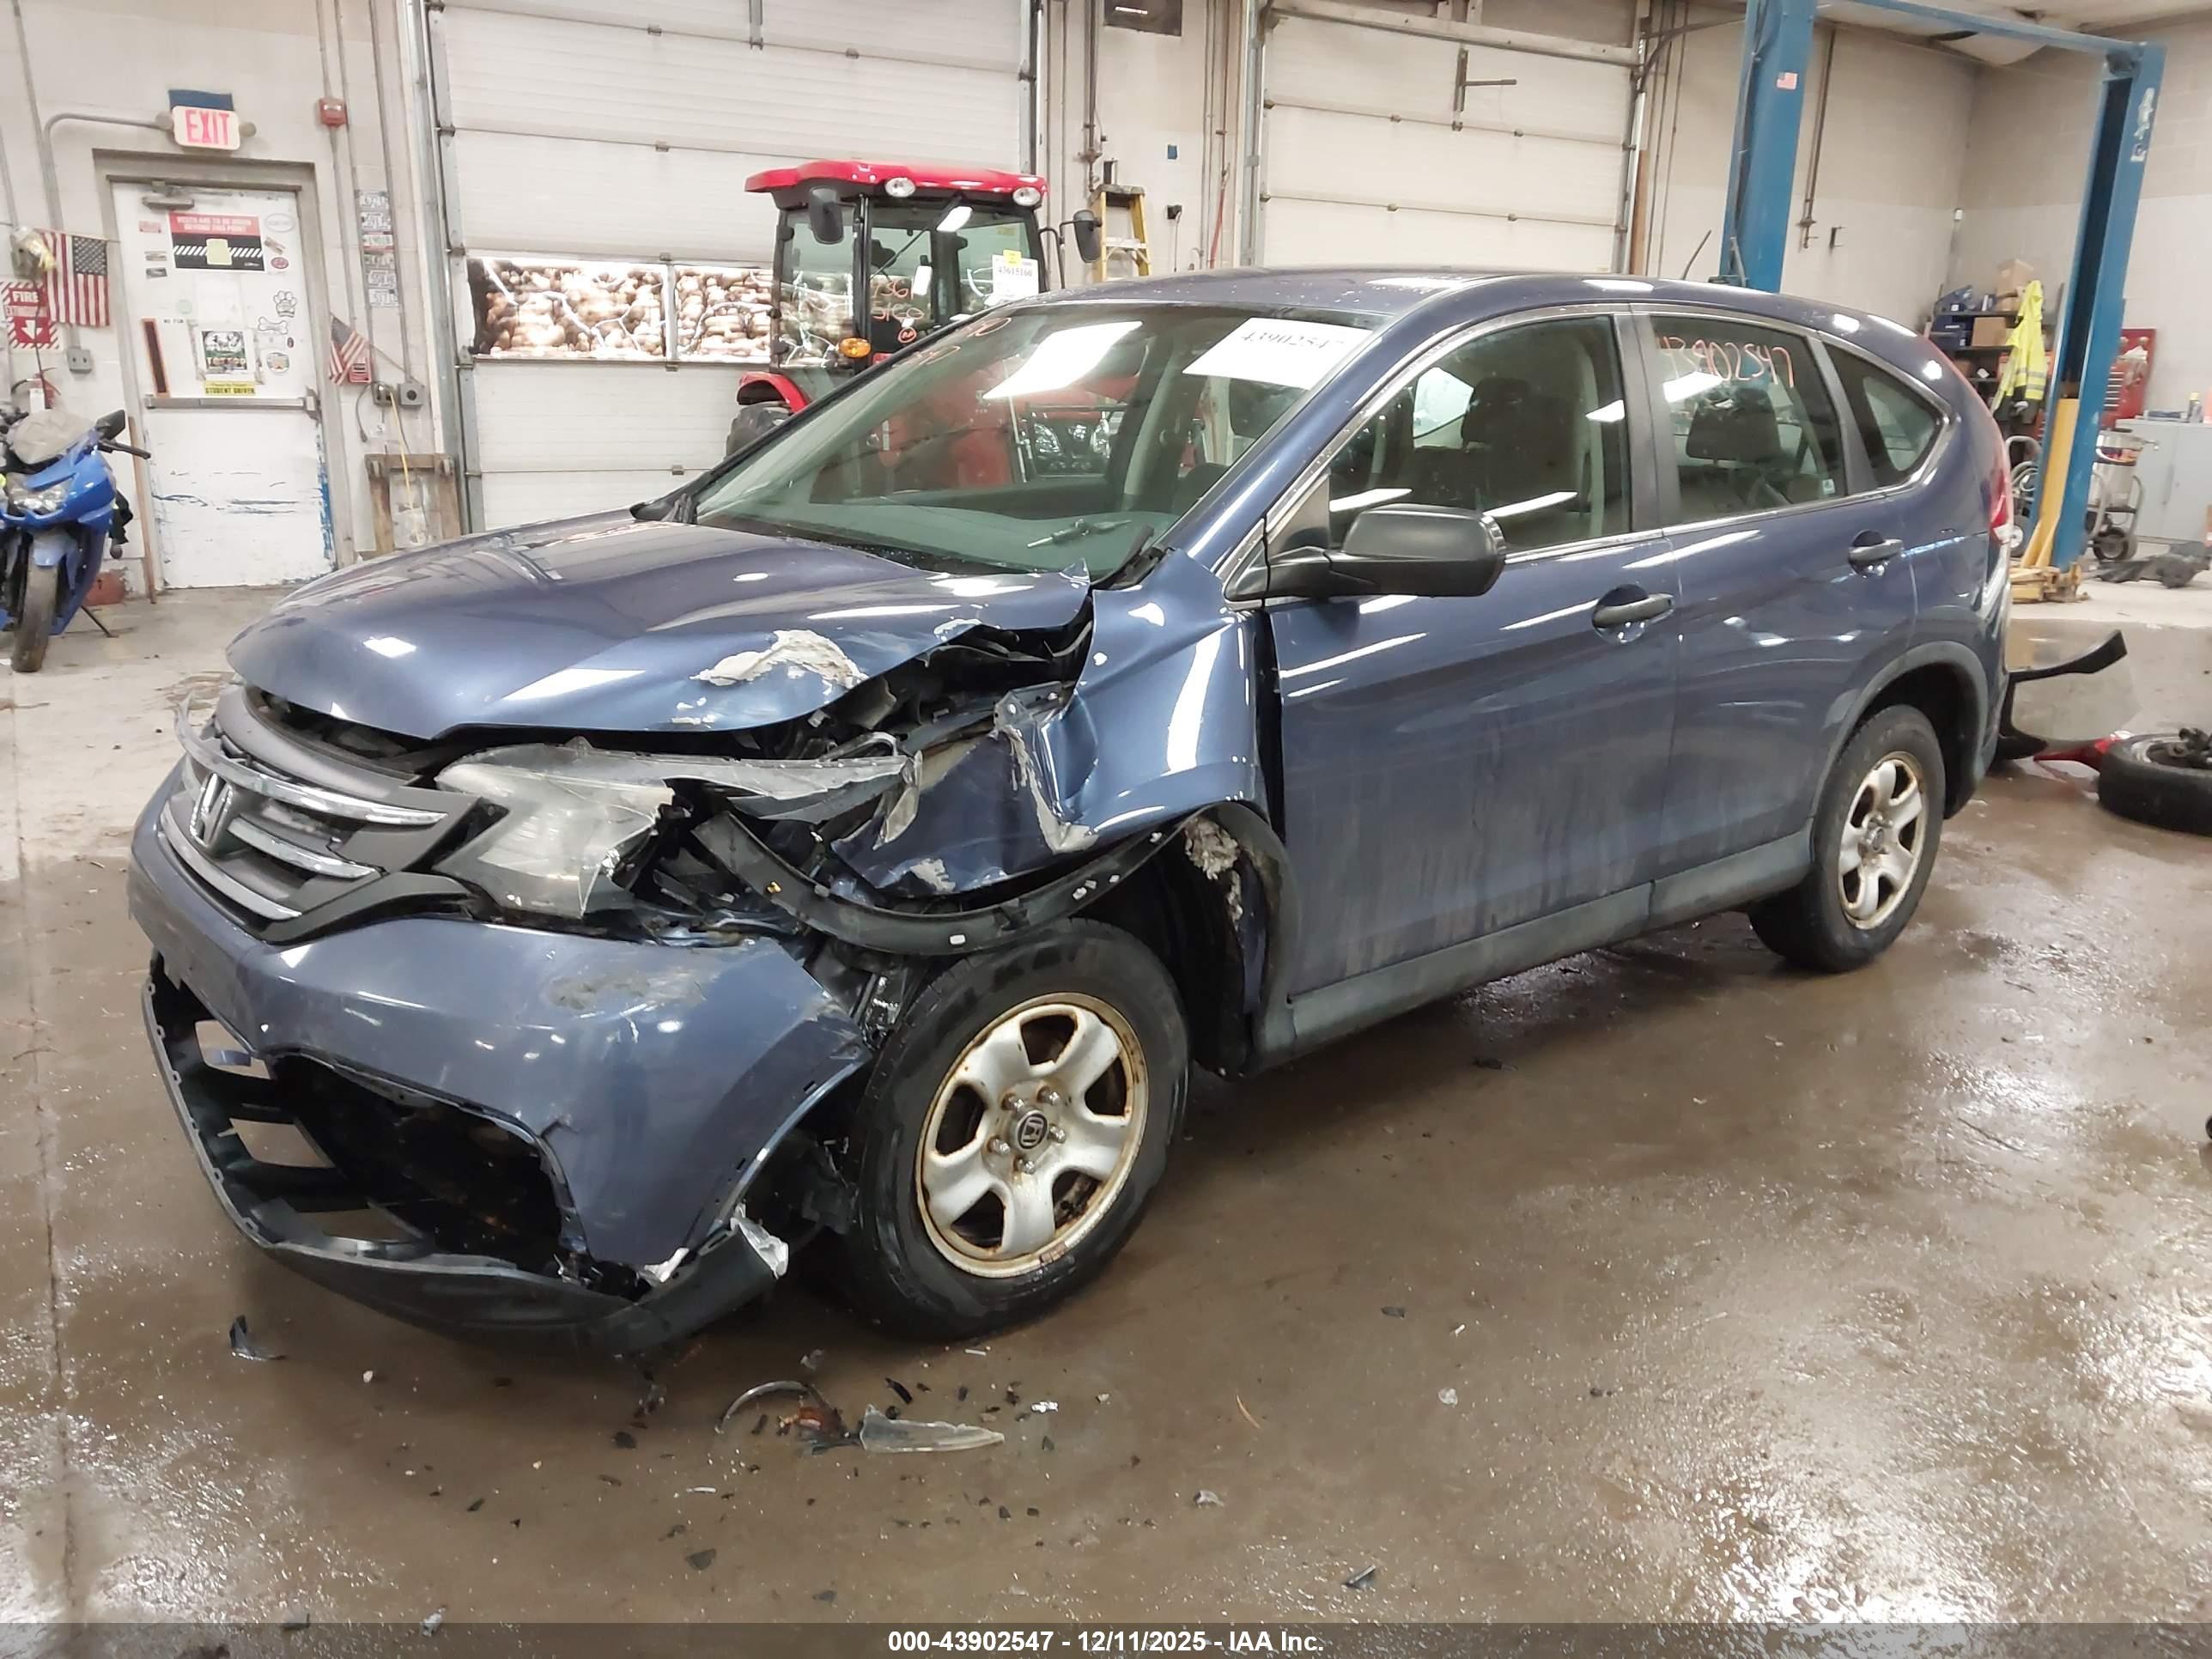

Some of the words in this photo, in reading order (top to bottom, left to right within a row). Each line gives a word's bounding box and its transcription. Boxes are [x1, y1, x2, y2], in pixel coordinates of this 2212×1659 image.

[185, 109, 229, 145] EXIT
[12, 290, 40, 303] FIRE
[1656, 336, 1796, 388] 43902547
